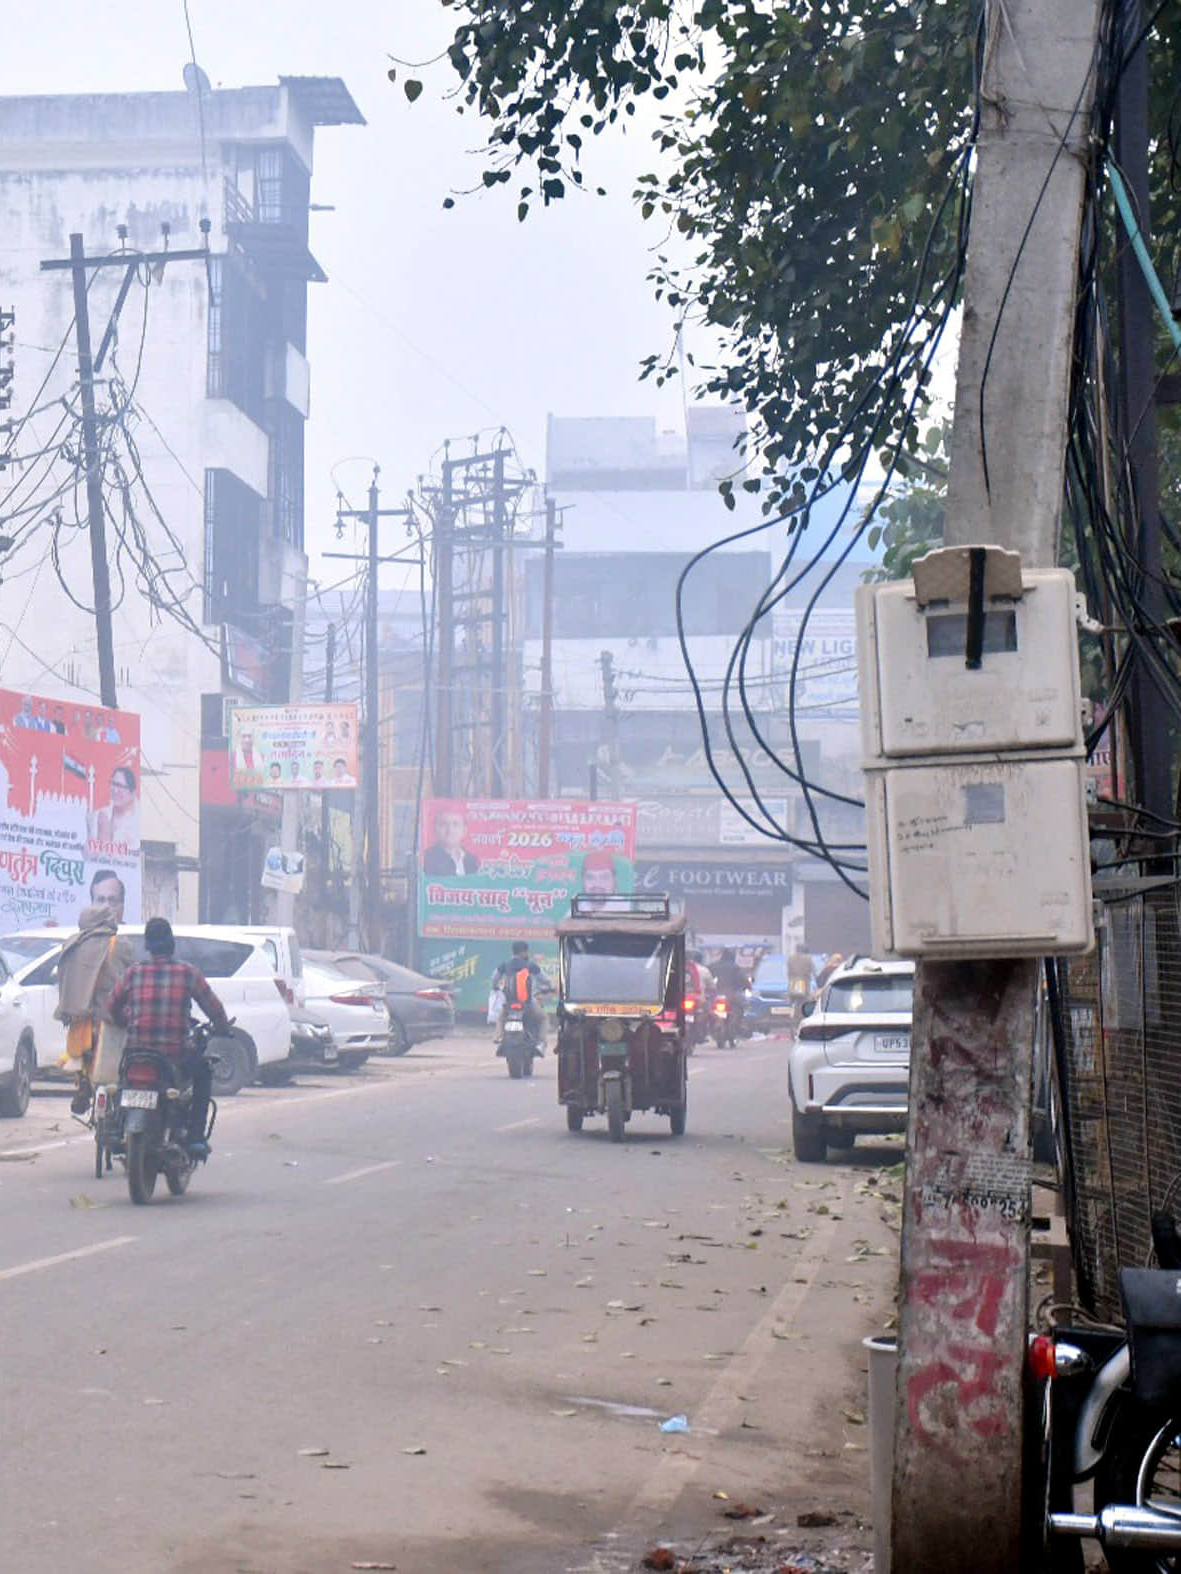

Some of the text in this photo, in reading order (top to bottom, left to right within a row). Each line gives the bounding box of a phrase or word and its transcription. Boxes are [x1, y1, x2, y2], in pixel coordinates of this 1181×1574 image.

[775, 640, 853, 656] NEW LIG
[508, 831, 553, 848] 2026
[40, 849, 86, 886] दिवस
[668, 870, 788, 887] FOOTWEAR
[882, 1039, 910, 1049] UP53
